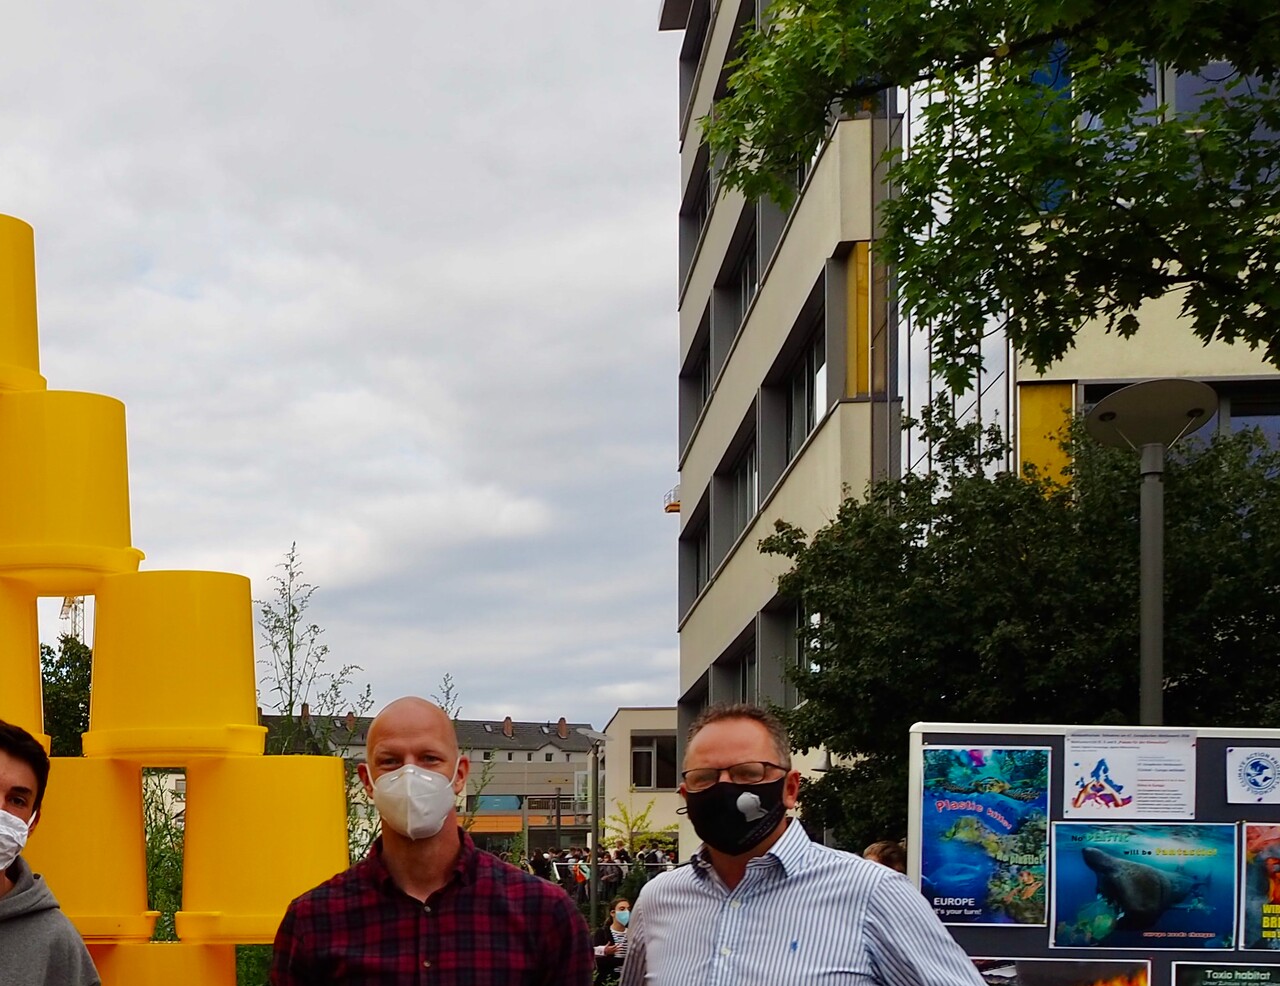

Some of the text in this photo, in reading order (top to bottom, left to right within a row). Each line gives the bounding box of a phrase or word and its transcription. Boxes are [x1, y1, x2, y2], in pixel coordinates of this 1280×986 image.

[935, 799, 984, 813] Plastic
[933, 897, 975, 906] EUROPE
[1262, 916, 1280, 928] BR
[1205, 969, 1271, 980] Toxic habitat
